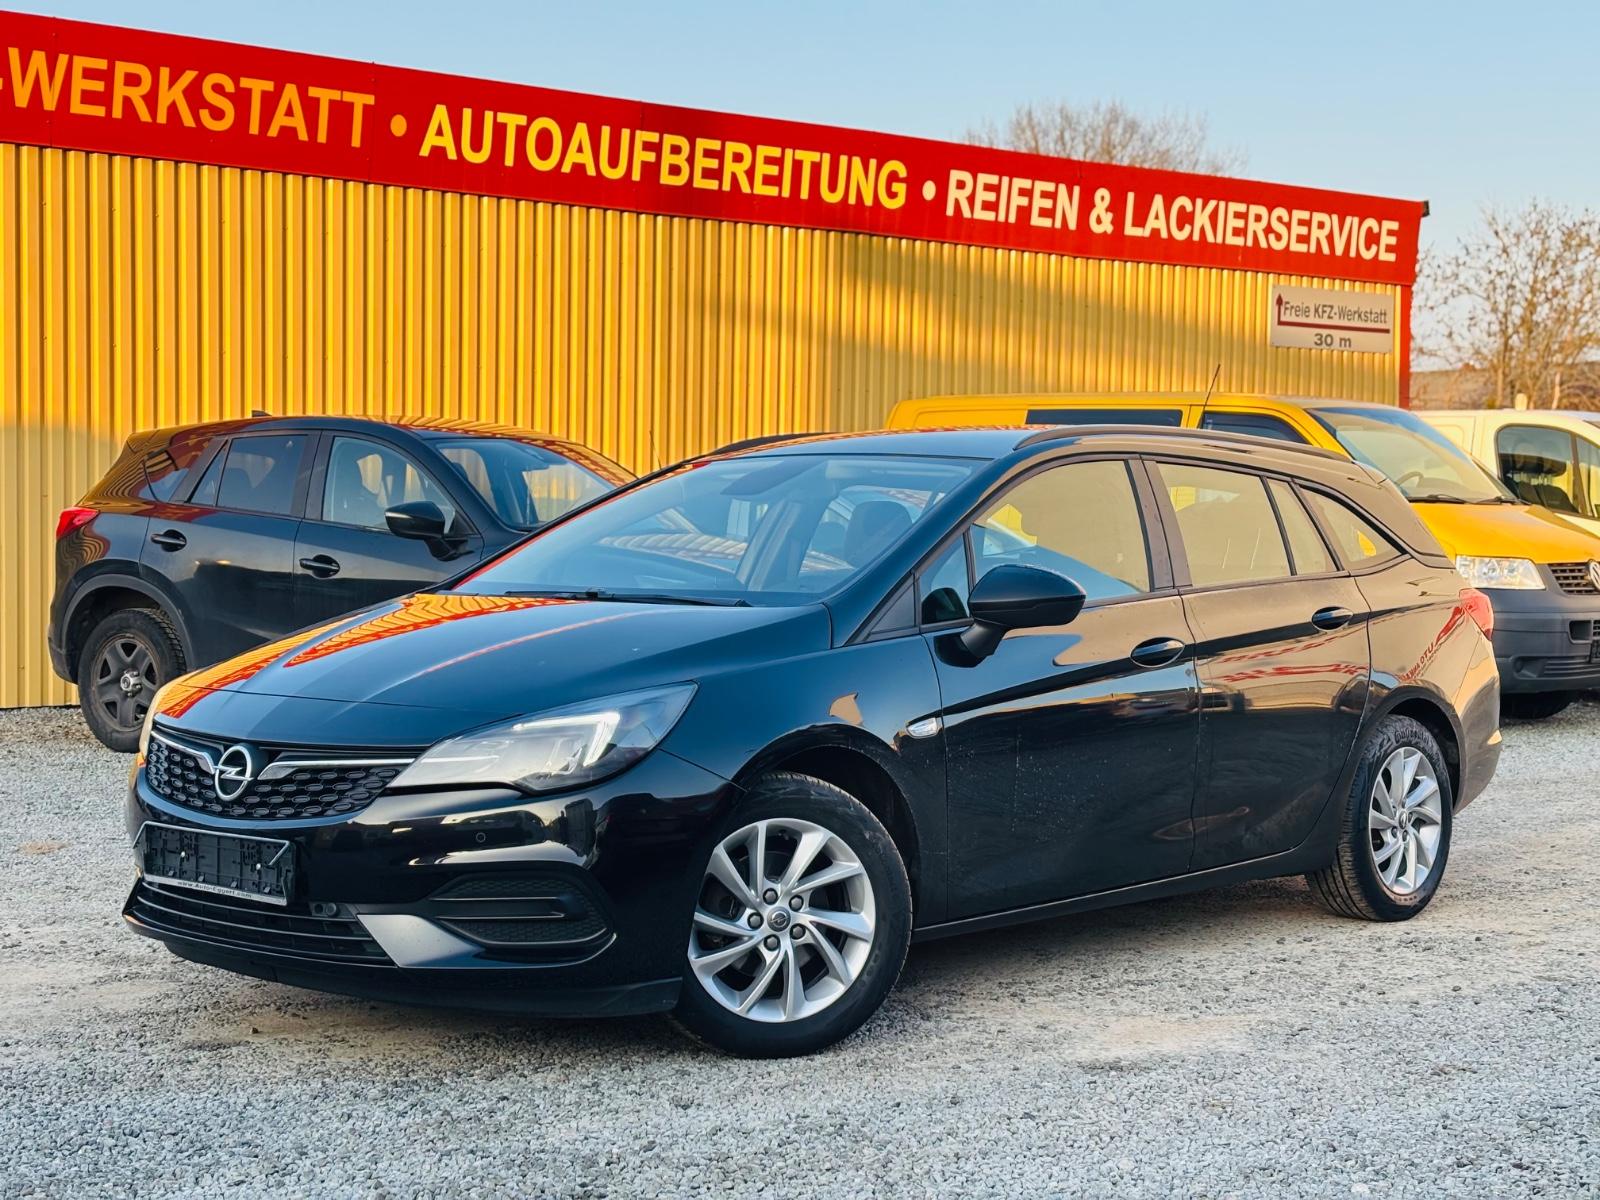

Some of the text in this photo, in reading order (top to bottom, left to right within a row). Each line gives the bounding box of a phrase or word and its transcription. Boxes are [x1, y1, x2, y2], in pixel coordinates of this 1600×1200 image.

[0, 48, 1399, 262] WERKSTATT AUTOAUFBEREITUNG REIFEN & LACKIERSERVICE
[1283, 301, 1388, 324] Freie KFZ-Werkstatt
[1314, 333, 1352, 348] 30 m
